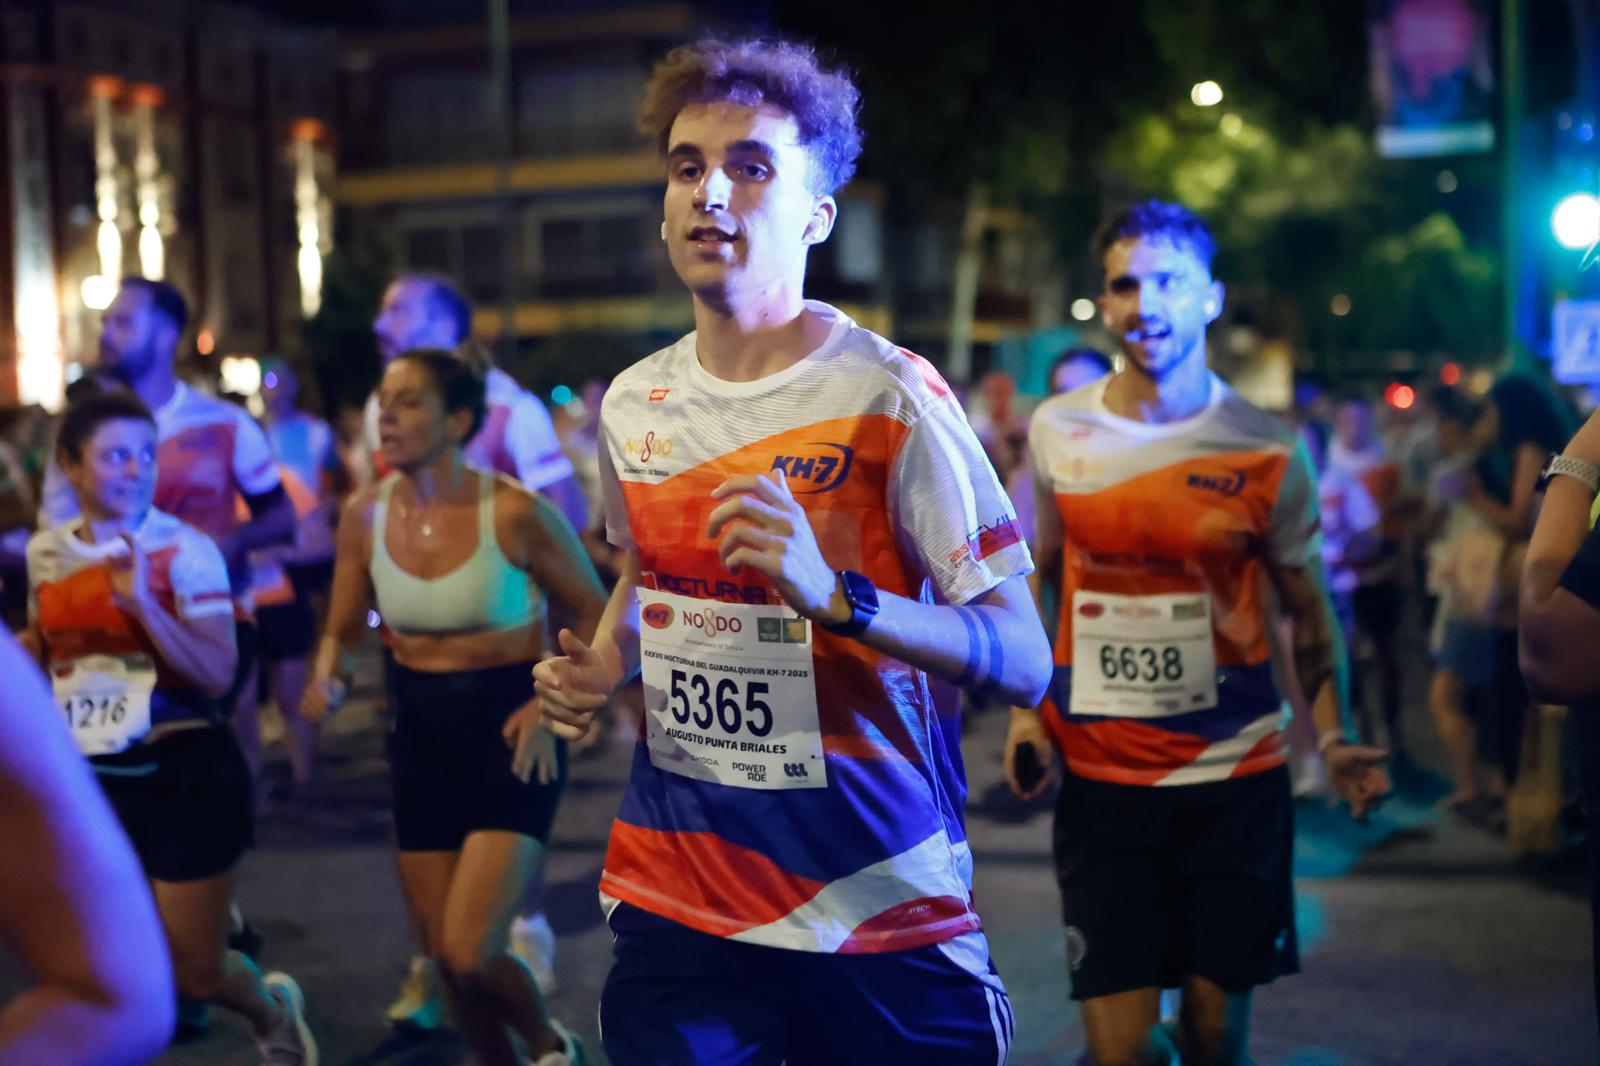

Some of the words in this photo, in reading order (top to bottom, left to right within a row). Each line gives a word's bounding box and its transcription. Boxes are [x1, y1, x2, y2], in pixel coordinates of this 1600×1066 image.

[664, 654, 695, 667] NOCTURNA
[696, 661, 708, 669] DEL
[709, 663, 765, 676] GUADALQUIVIR
[788, 670, 808, 678] 2025
[1100, 645, 1183, 682] 6638
[671, 669, 773, 737] 5365
[666, 728, 704, 744] AUGUSTO
[705, 737, 738, 750] PUNTA
[740, 742, 787, 754] BRIALES
[732, 762, 766, 773] POWER
